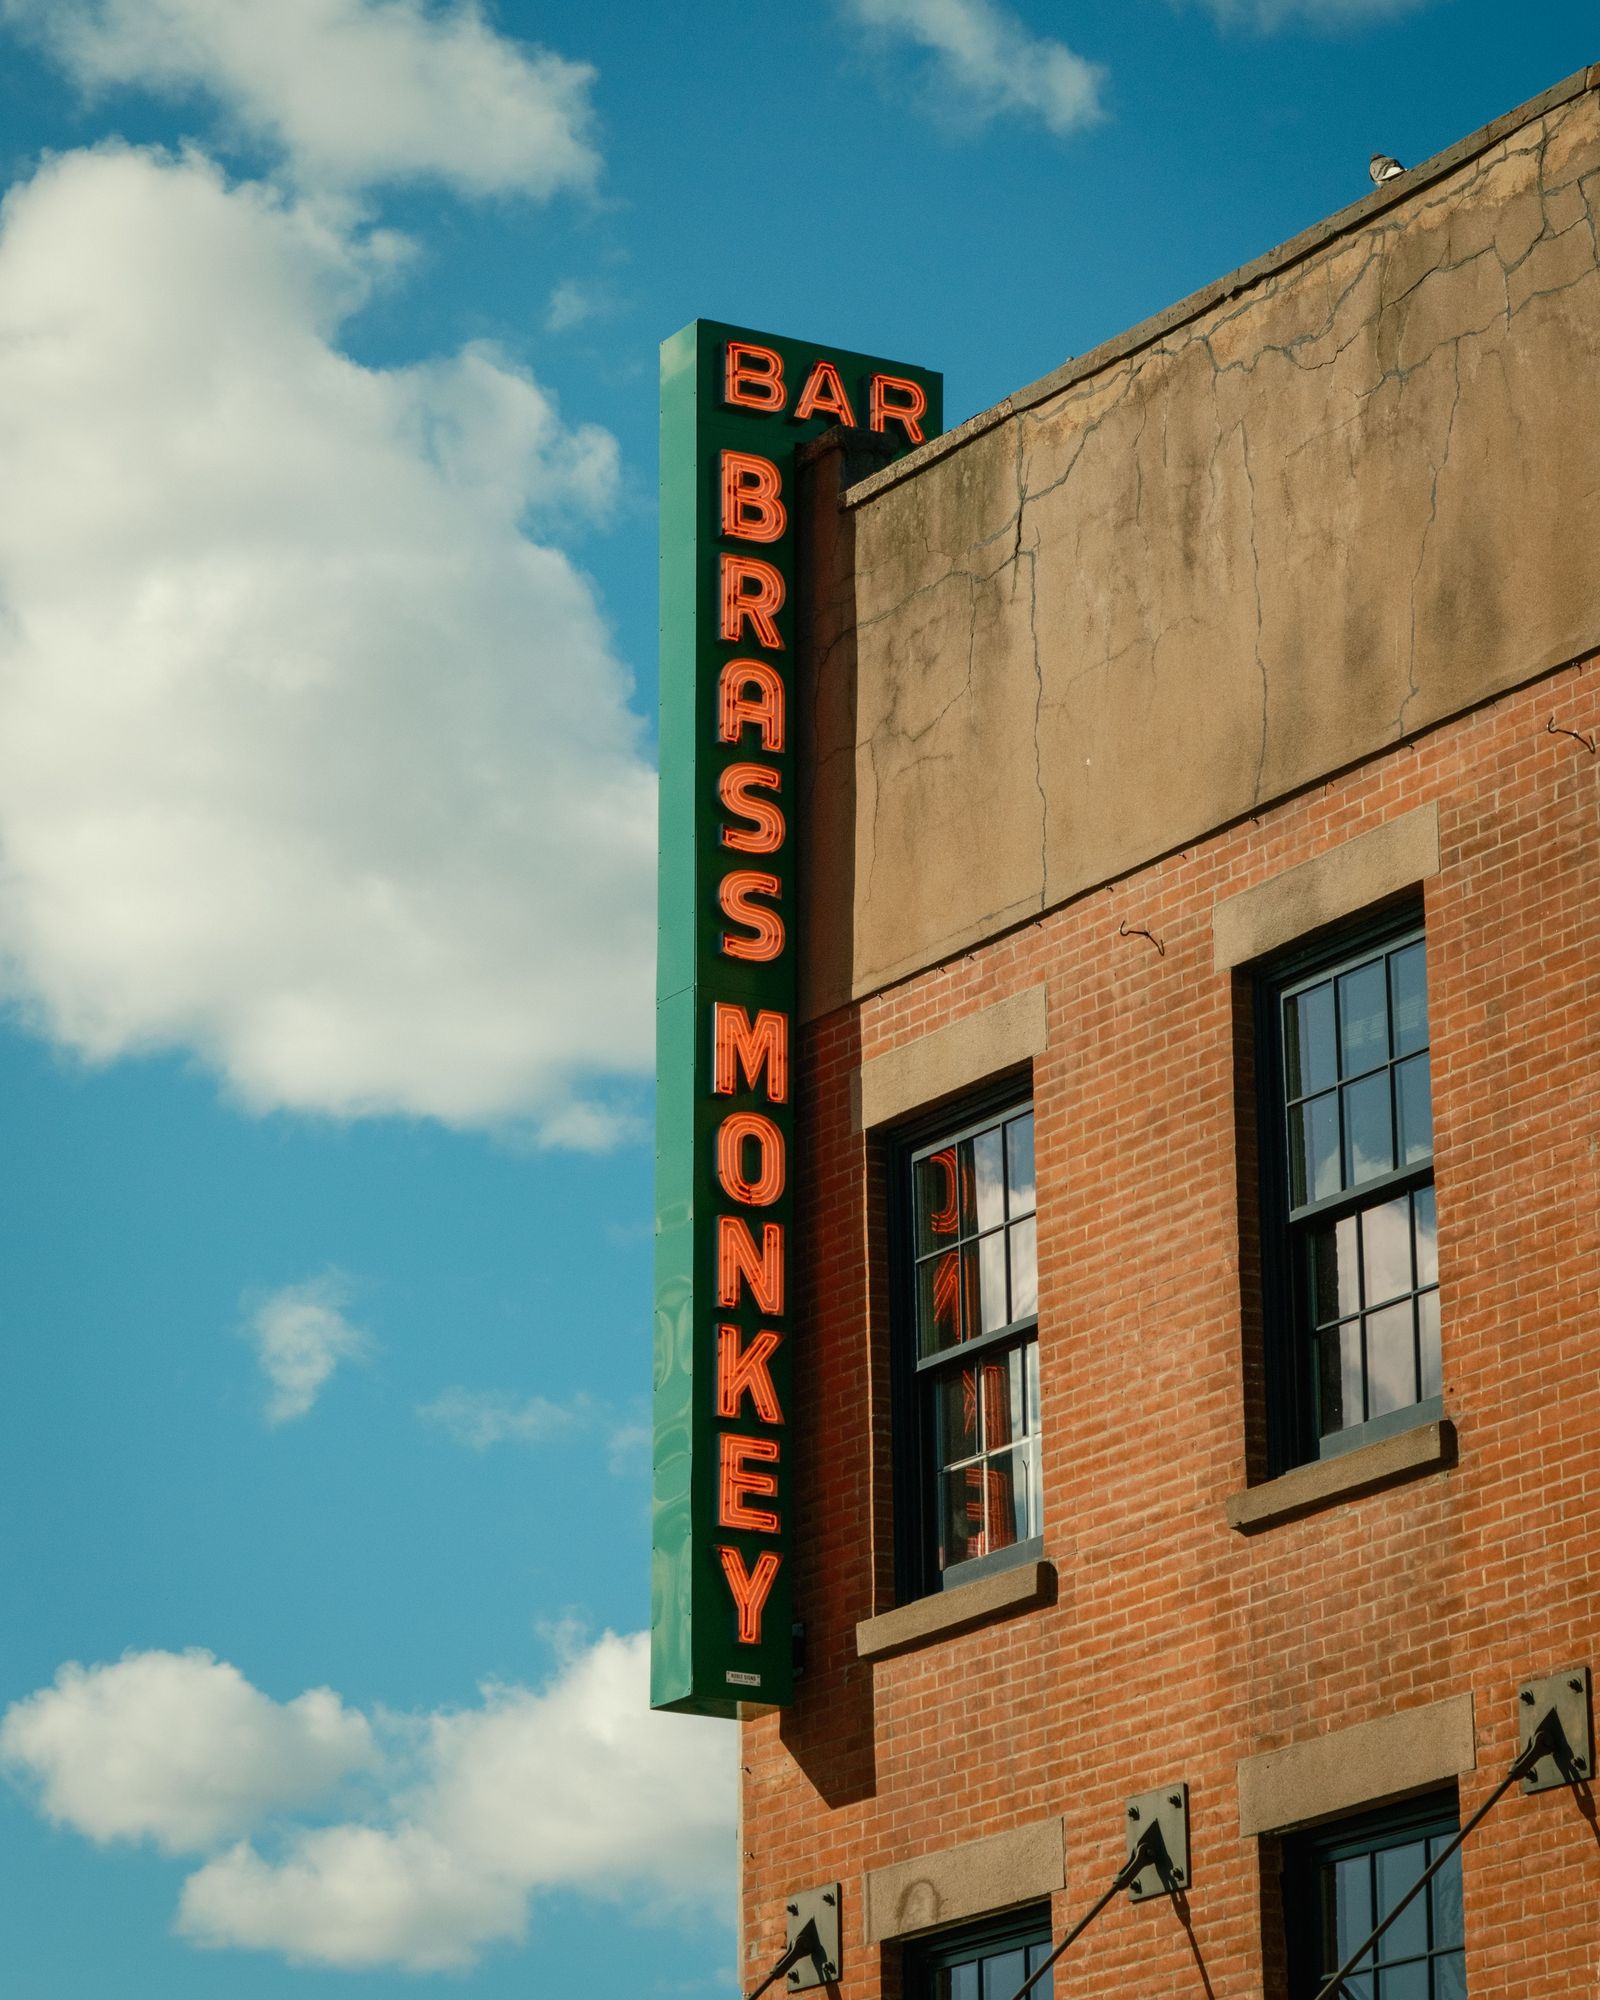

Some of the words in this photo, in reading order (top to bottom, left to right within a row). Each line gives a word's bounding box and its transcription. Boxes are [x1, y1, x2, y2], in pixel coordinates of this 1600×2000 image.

[725, 339, 927, 445] BAR
[719, 448, 787, 962] BRASS
[713, 1001, 789, 1645] MONKEY
